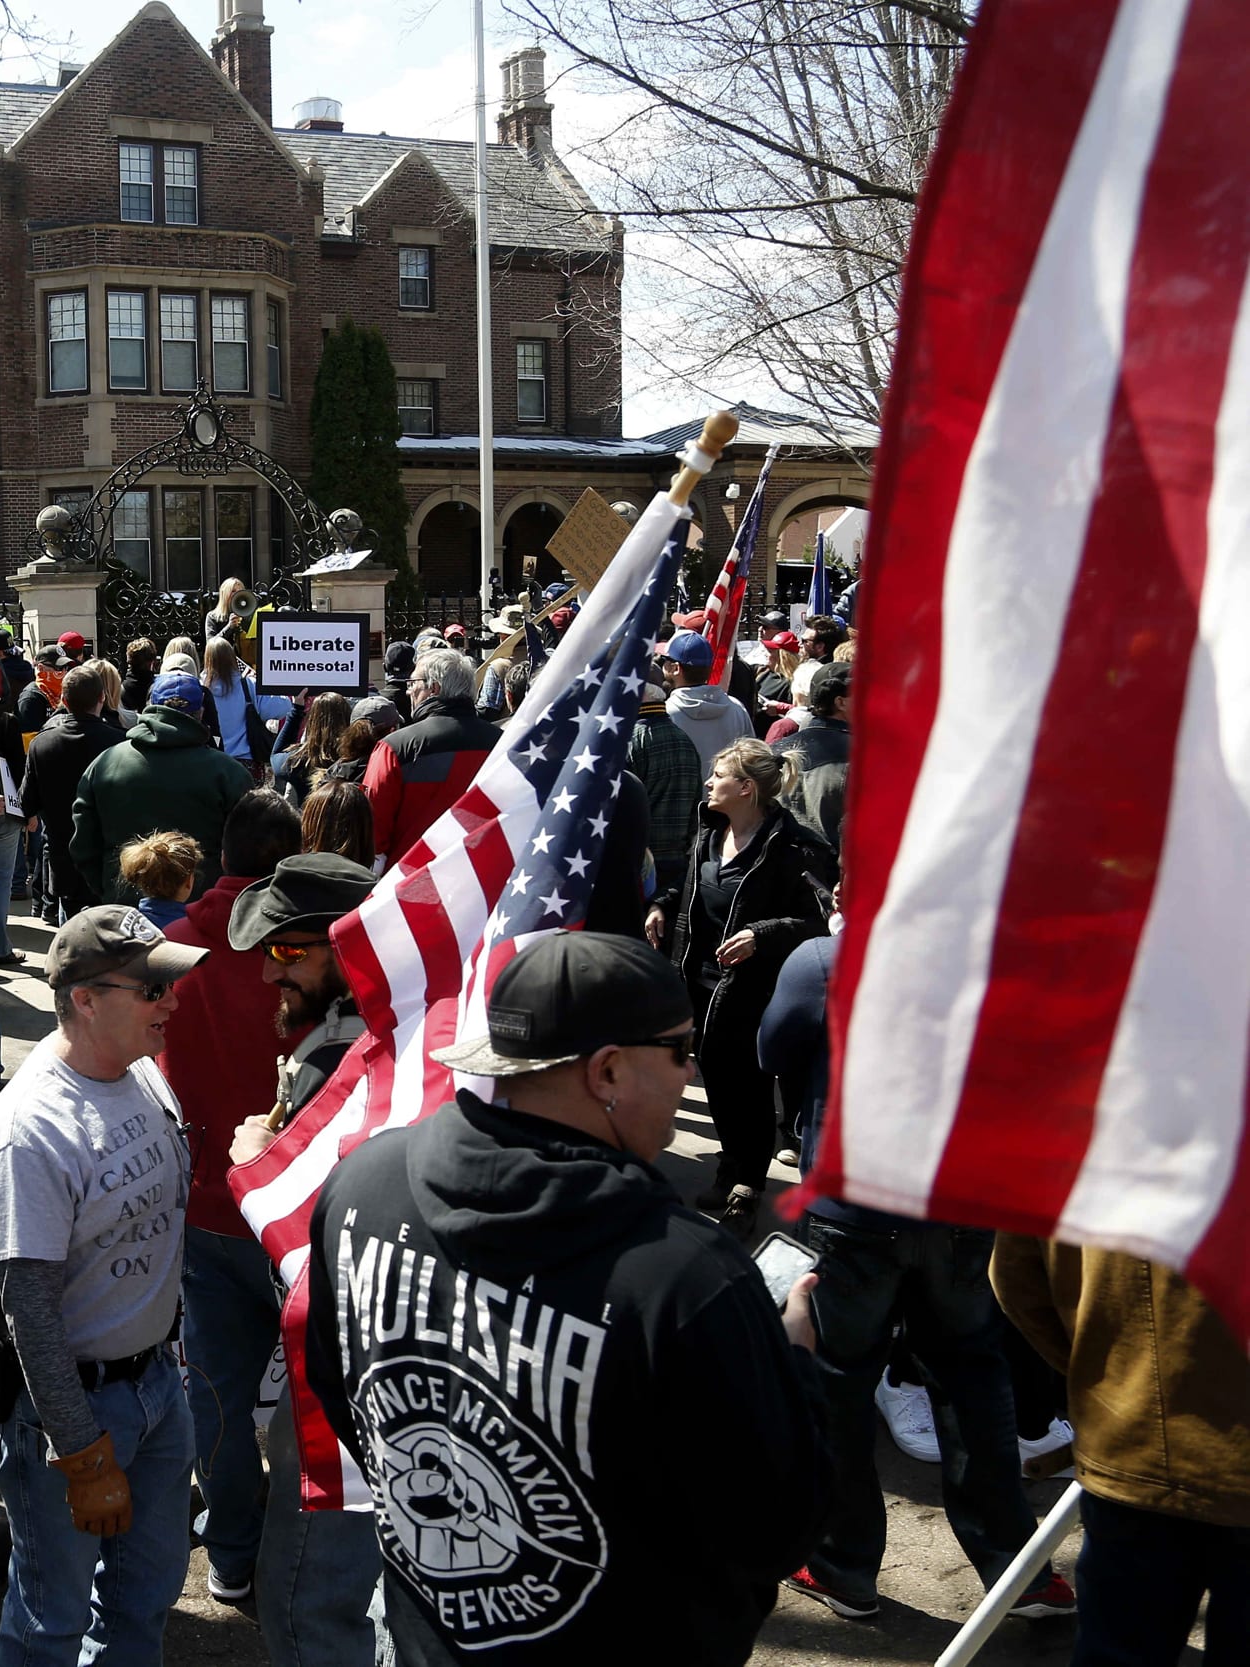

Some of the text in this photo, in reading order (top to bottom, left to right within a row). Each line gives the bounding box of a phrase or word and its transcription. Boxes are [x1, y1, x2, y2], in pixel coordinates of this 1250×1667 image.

[269, 636, 355, 651] Liberate
[269, 660, 354, 672] Minnesota!
[100, 1141, 165, 1193] CALM
[117, 1183, 163, 1223] AND
[110, 1254, 152, 1279] ON
[337, 1228, 606, 1480] MULISHA
[366, 1373, 447, 1428] SINCE
